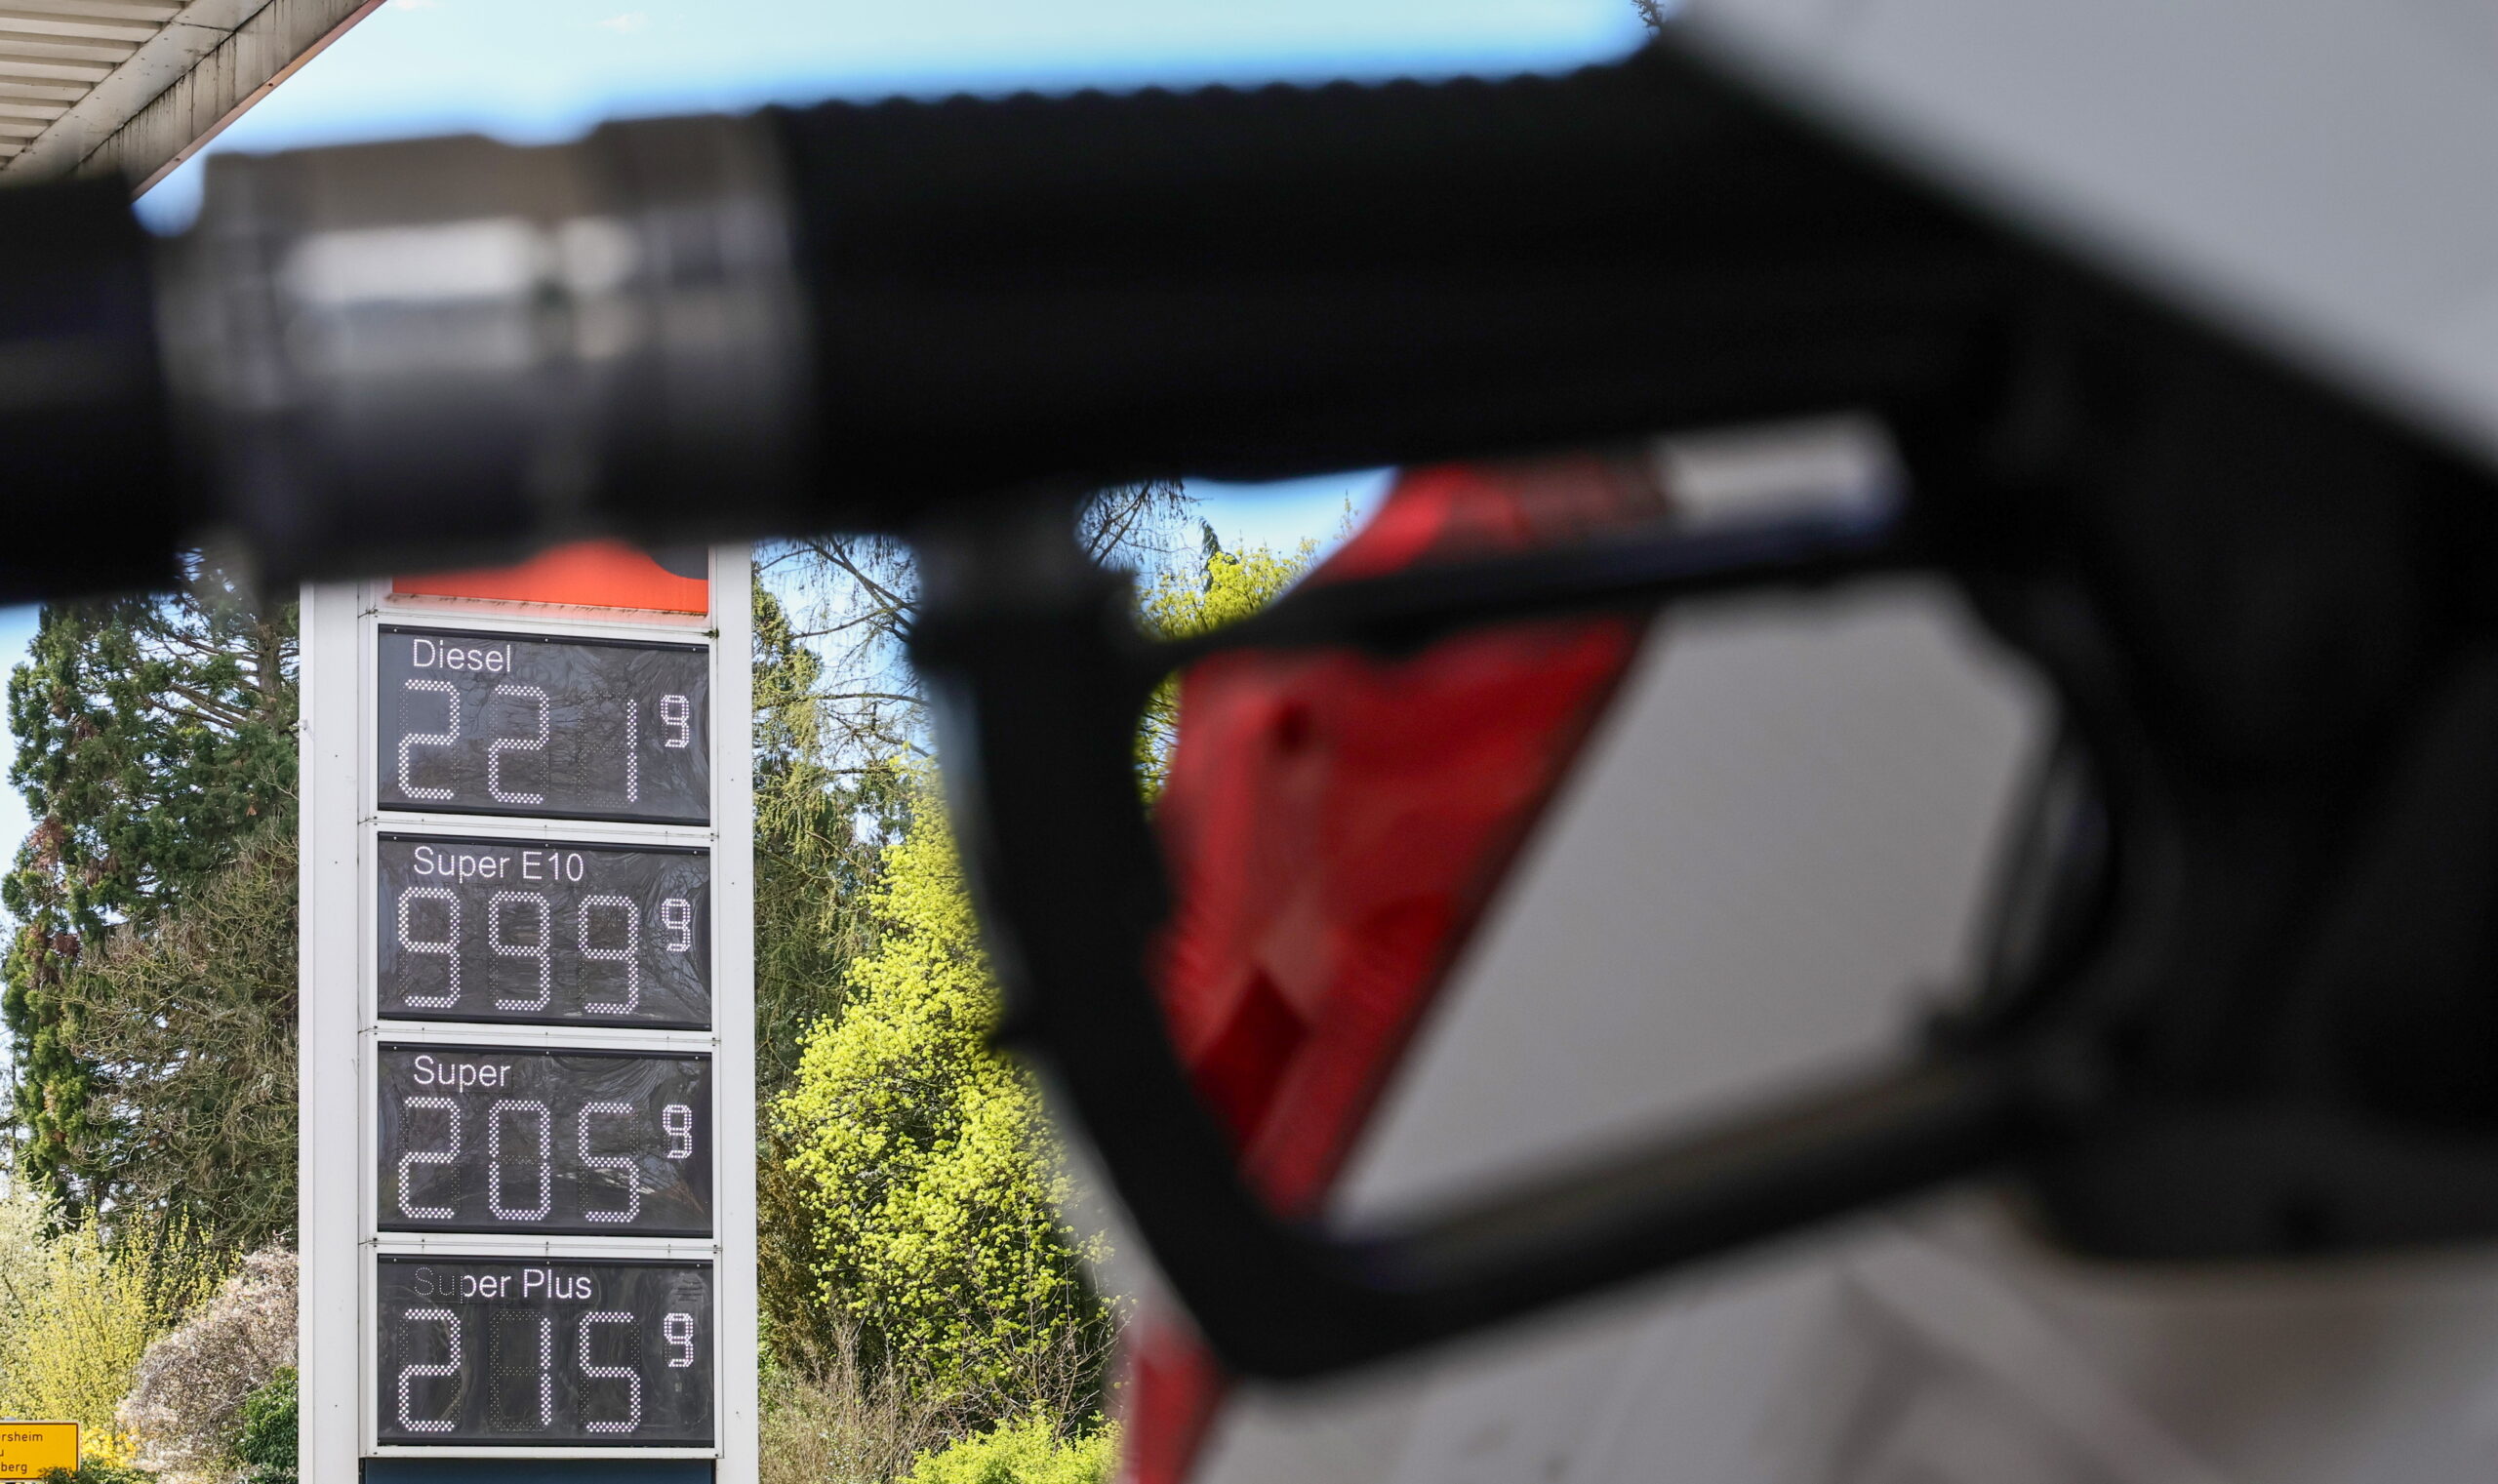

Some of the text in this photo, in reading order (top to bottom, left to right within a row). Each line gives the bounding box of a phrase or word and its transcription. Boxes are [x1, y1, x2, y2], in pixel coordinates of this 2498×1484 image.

[412, 638, 512, 673] Diesel
[413, 845, 584, 884] Super E10
[413, 1054, 511, 1093] Super
[413, 1266, 593, 1304] Super Plus
[1, 1462, 27, 1474] berg
